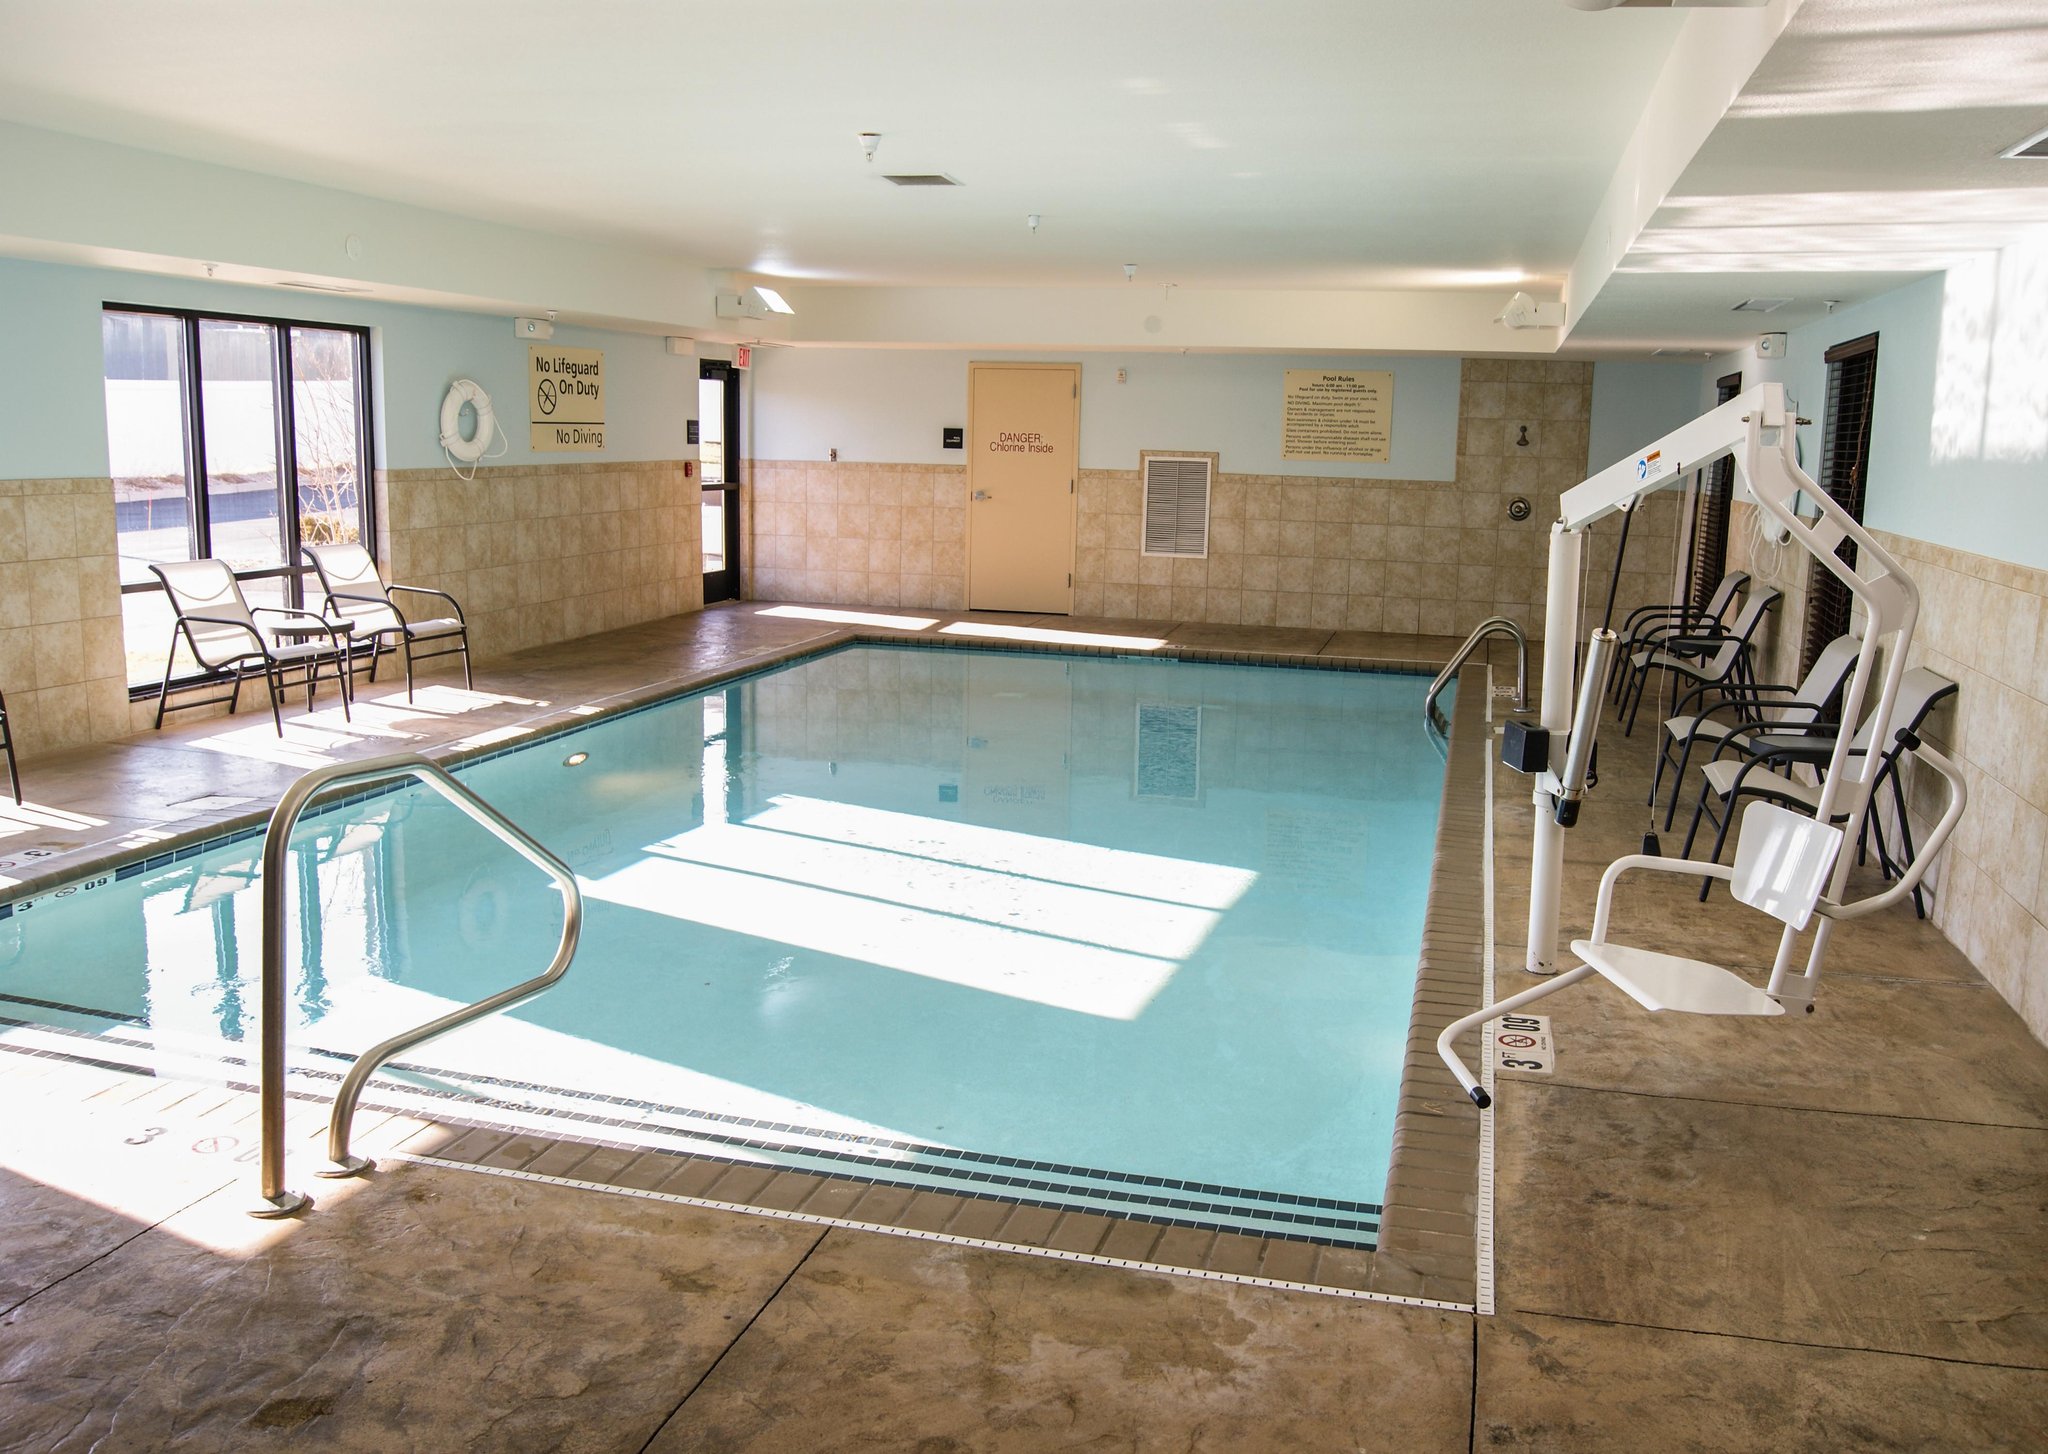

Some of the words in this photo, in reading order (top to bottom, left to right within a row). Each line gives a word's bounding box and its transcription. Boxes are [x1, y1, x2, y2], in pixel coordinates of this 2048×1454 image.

[739, 348, 750, 367] EXIT
[536, 356, 550, 372] No
[554, 358, 599, 378] Lifeguard
[560, 379, 574, 395] On
[577, 380, 600, 400] Duty
[556, 429, 570, 444] No
[573, 429, 602, 448] Diving
[990, 442, 1025, 453] Chlorine
[1028, 444, 1054, 454] Inside
[17, 901, 33, 912] 3
[1502, 1059, 1543, 1070] 3
[124, 1127, 168, 1145] 3
